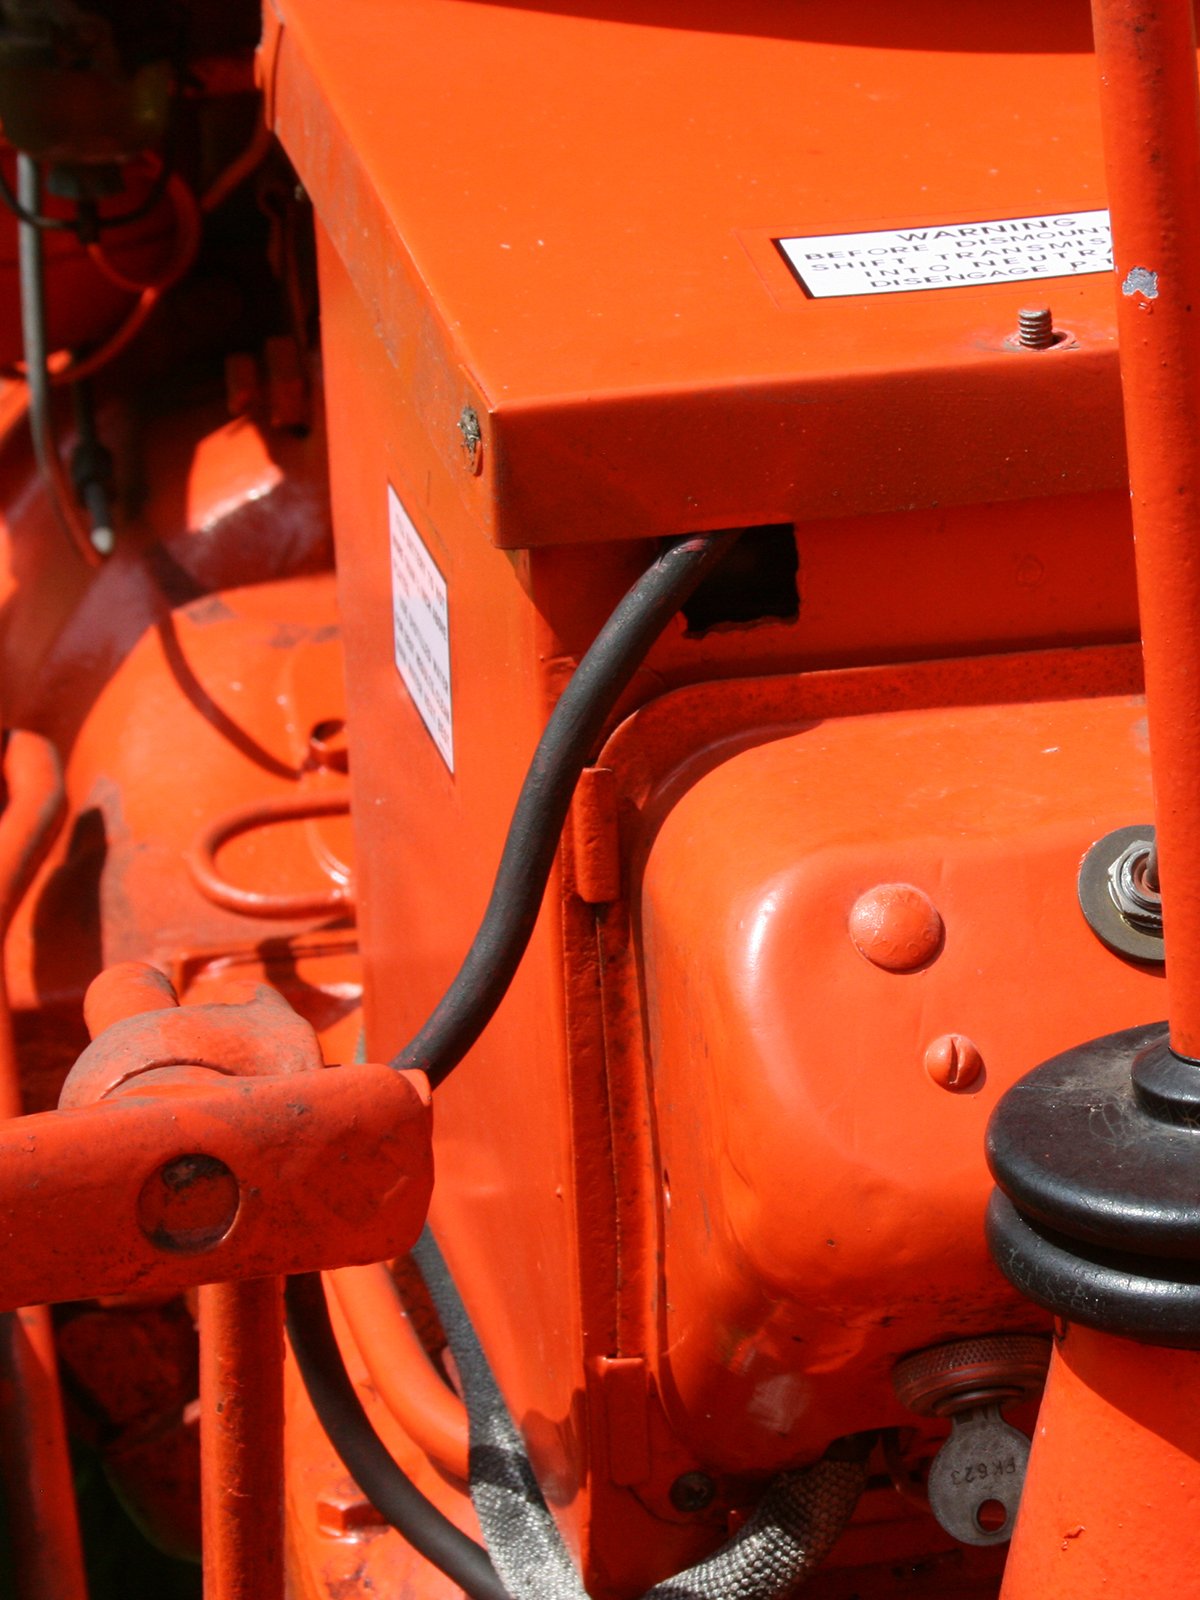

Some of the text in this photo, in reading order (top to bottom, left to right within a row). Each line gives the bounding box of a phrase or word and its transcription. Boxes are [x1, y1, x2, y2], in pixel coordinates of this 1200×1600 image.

[897, 218, 1076, 241] WARNING
[804, 244, 929, 260] BEFORE
[811, 258, 907, 271] SHIFT
[865, 265, 950, 277] INTO
[870, 265, 1049, 287] DISENGAGE
